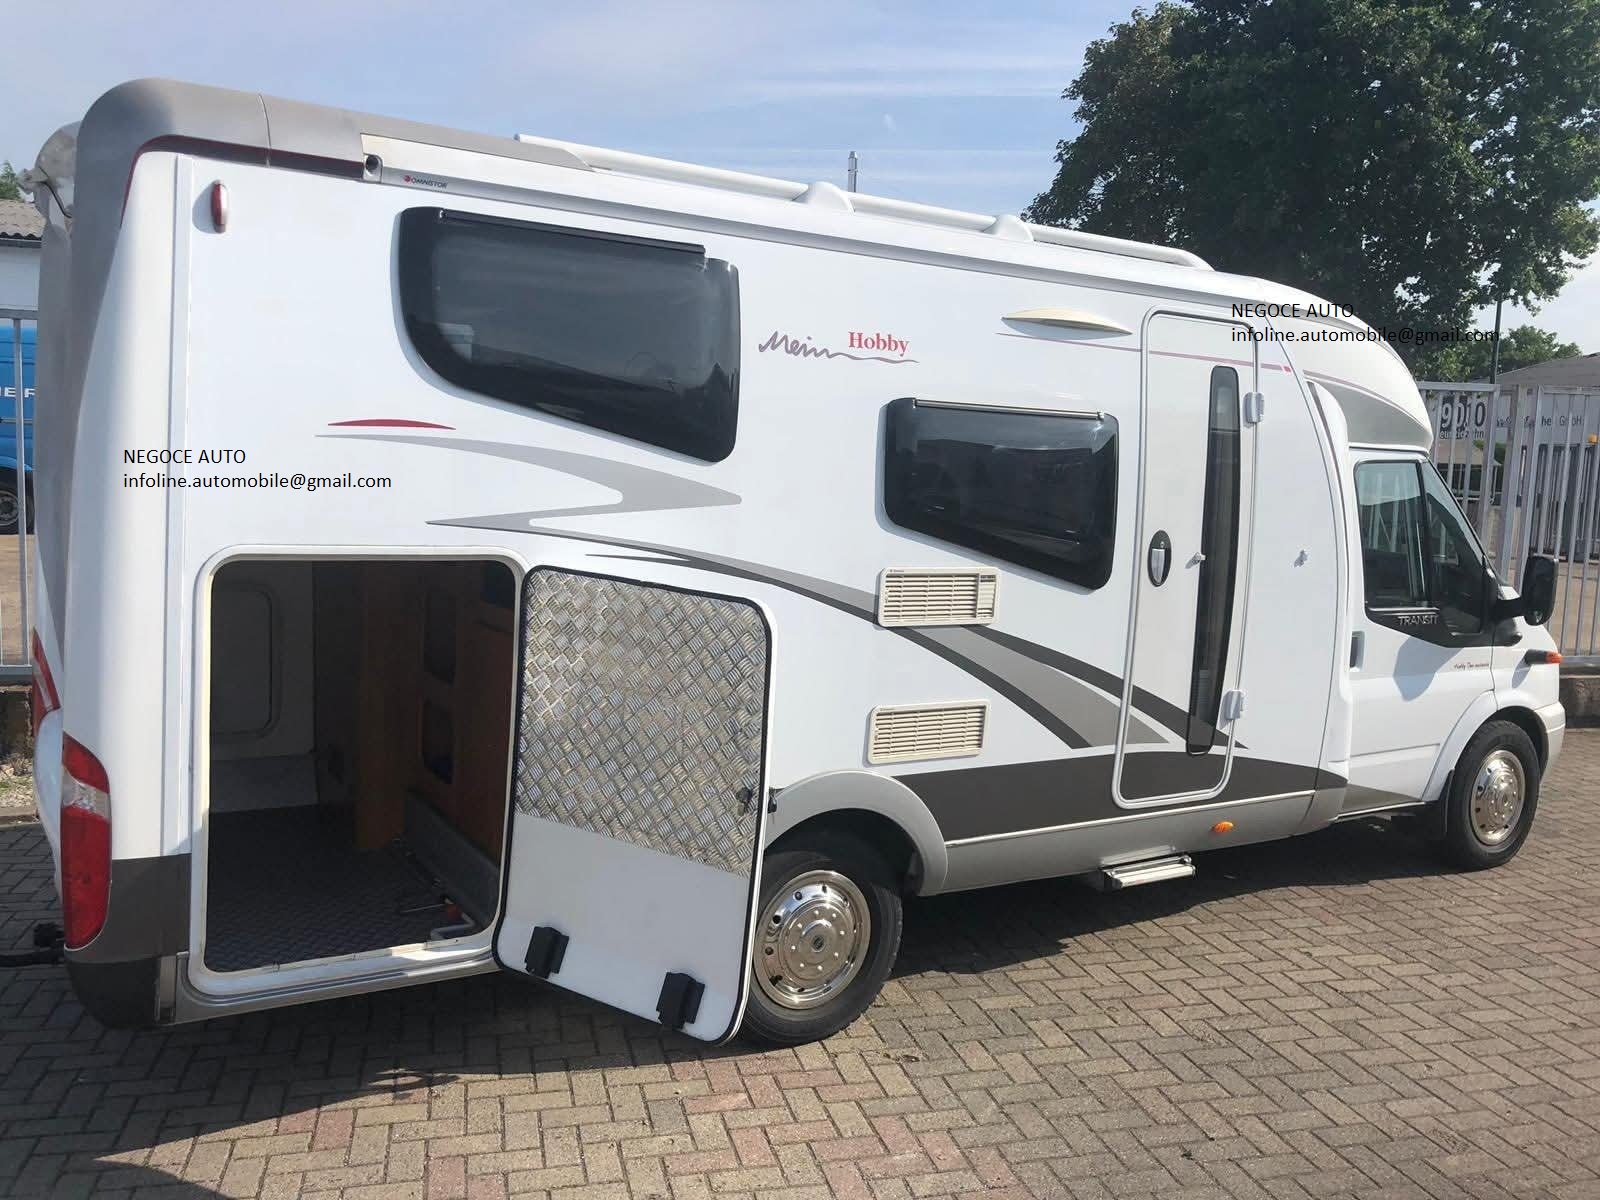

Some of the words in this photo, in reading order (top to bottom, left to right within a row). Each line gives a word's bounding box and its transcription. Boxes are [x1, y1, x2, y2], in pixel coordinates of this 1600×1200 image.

[758, 331, 840, 359] Mein
[848, 331, 910, 357] Hobby
[1398, 615, 1439, 625] TRANSIT
